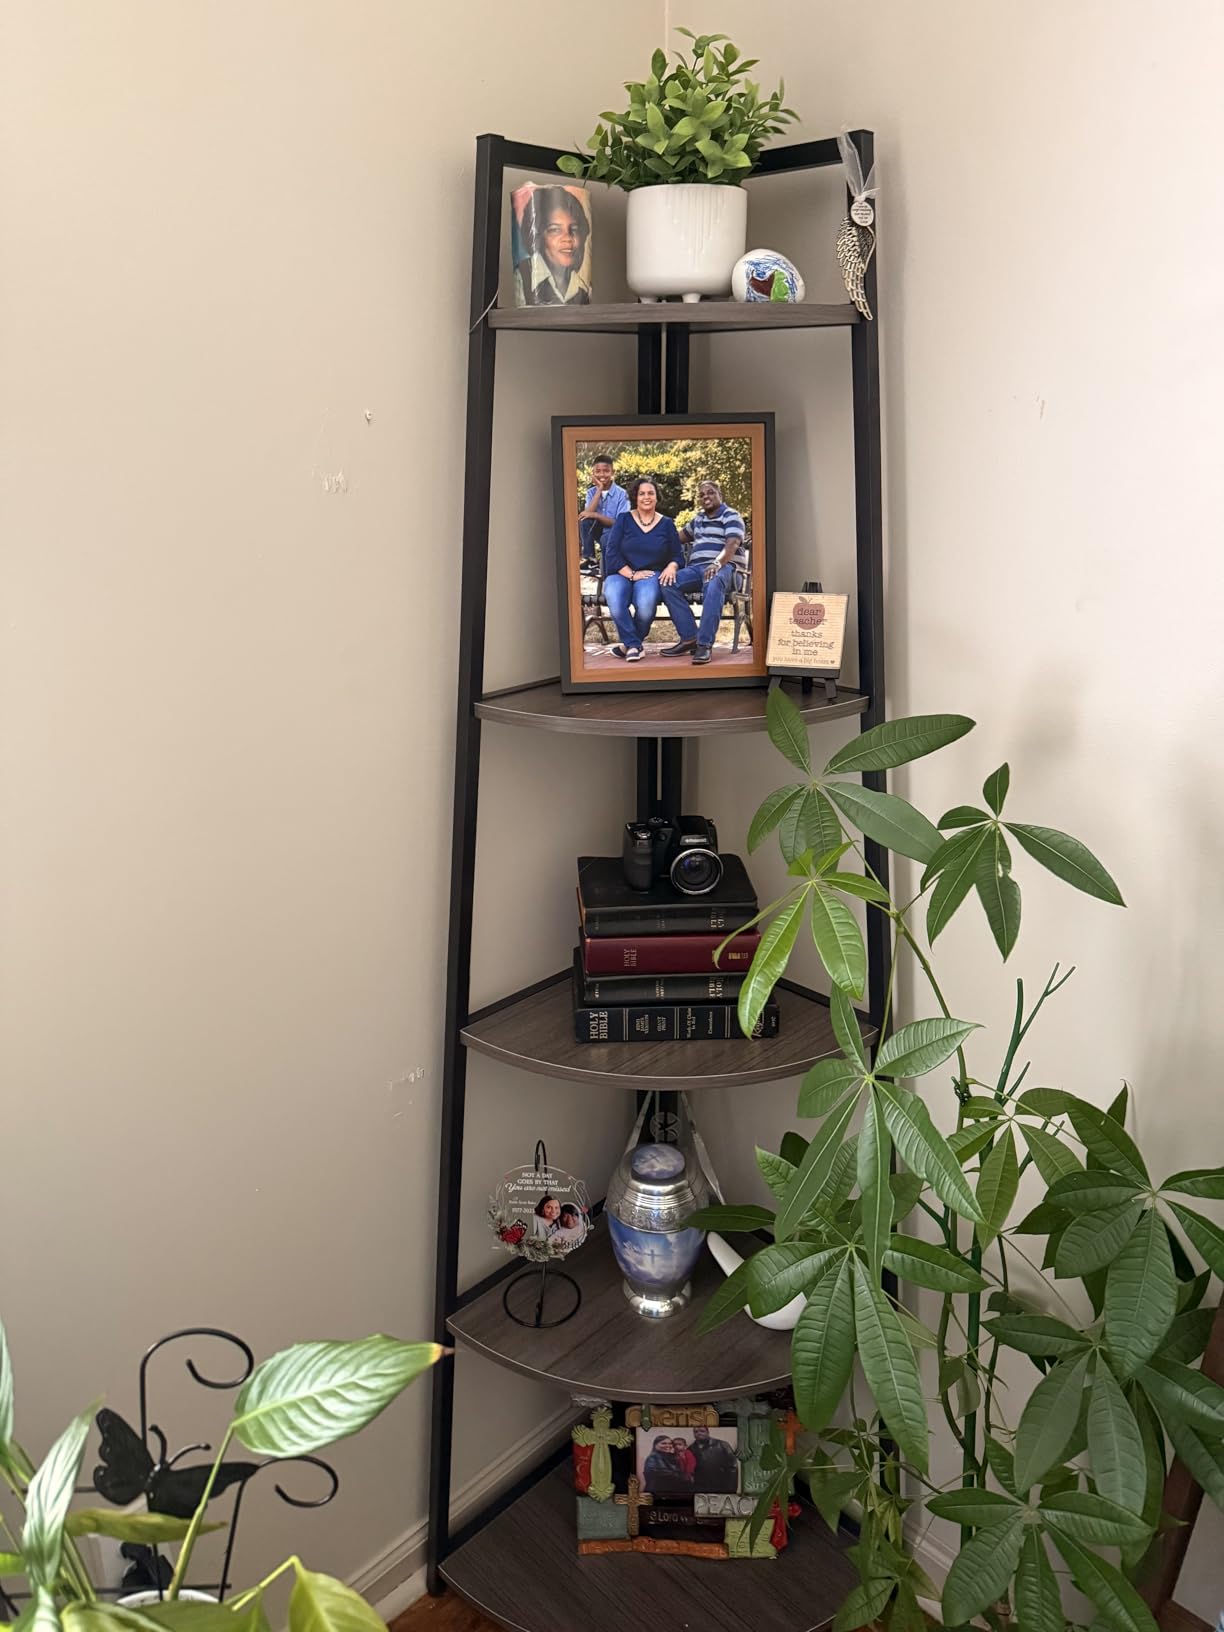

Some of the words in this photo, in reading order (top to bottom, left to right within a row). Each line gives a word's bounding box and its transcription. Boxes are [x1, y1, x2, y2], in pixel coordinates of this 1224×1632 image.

[797, 608, 822, 616] dear
[788, 617, 828, 626] teacher
[791, 630, 823, 638] thanks
[778, 638, 791, 646] for
[792, 639, 835, 649] believing
[590, 1012, 598, 1039] HOLY
[599, 1010, 608, 1039] BIBLE
[505, 1182, 523, 1192] You
